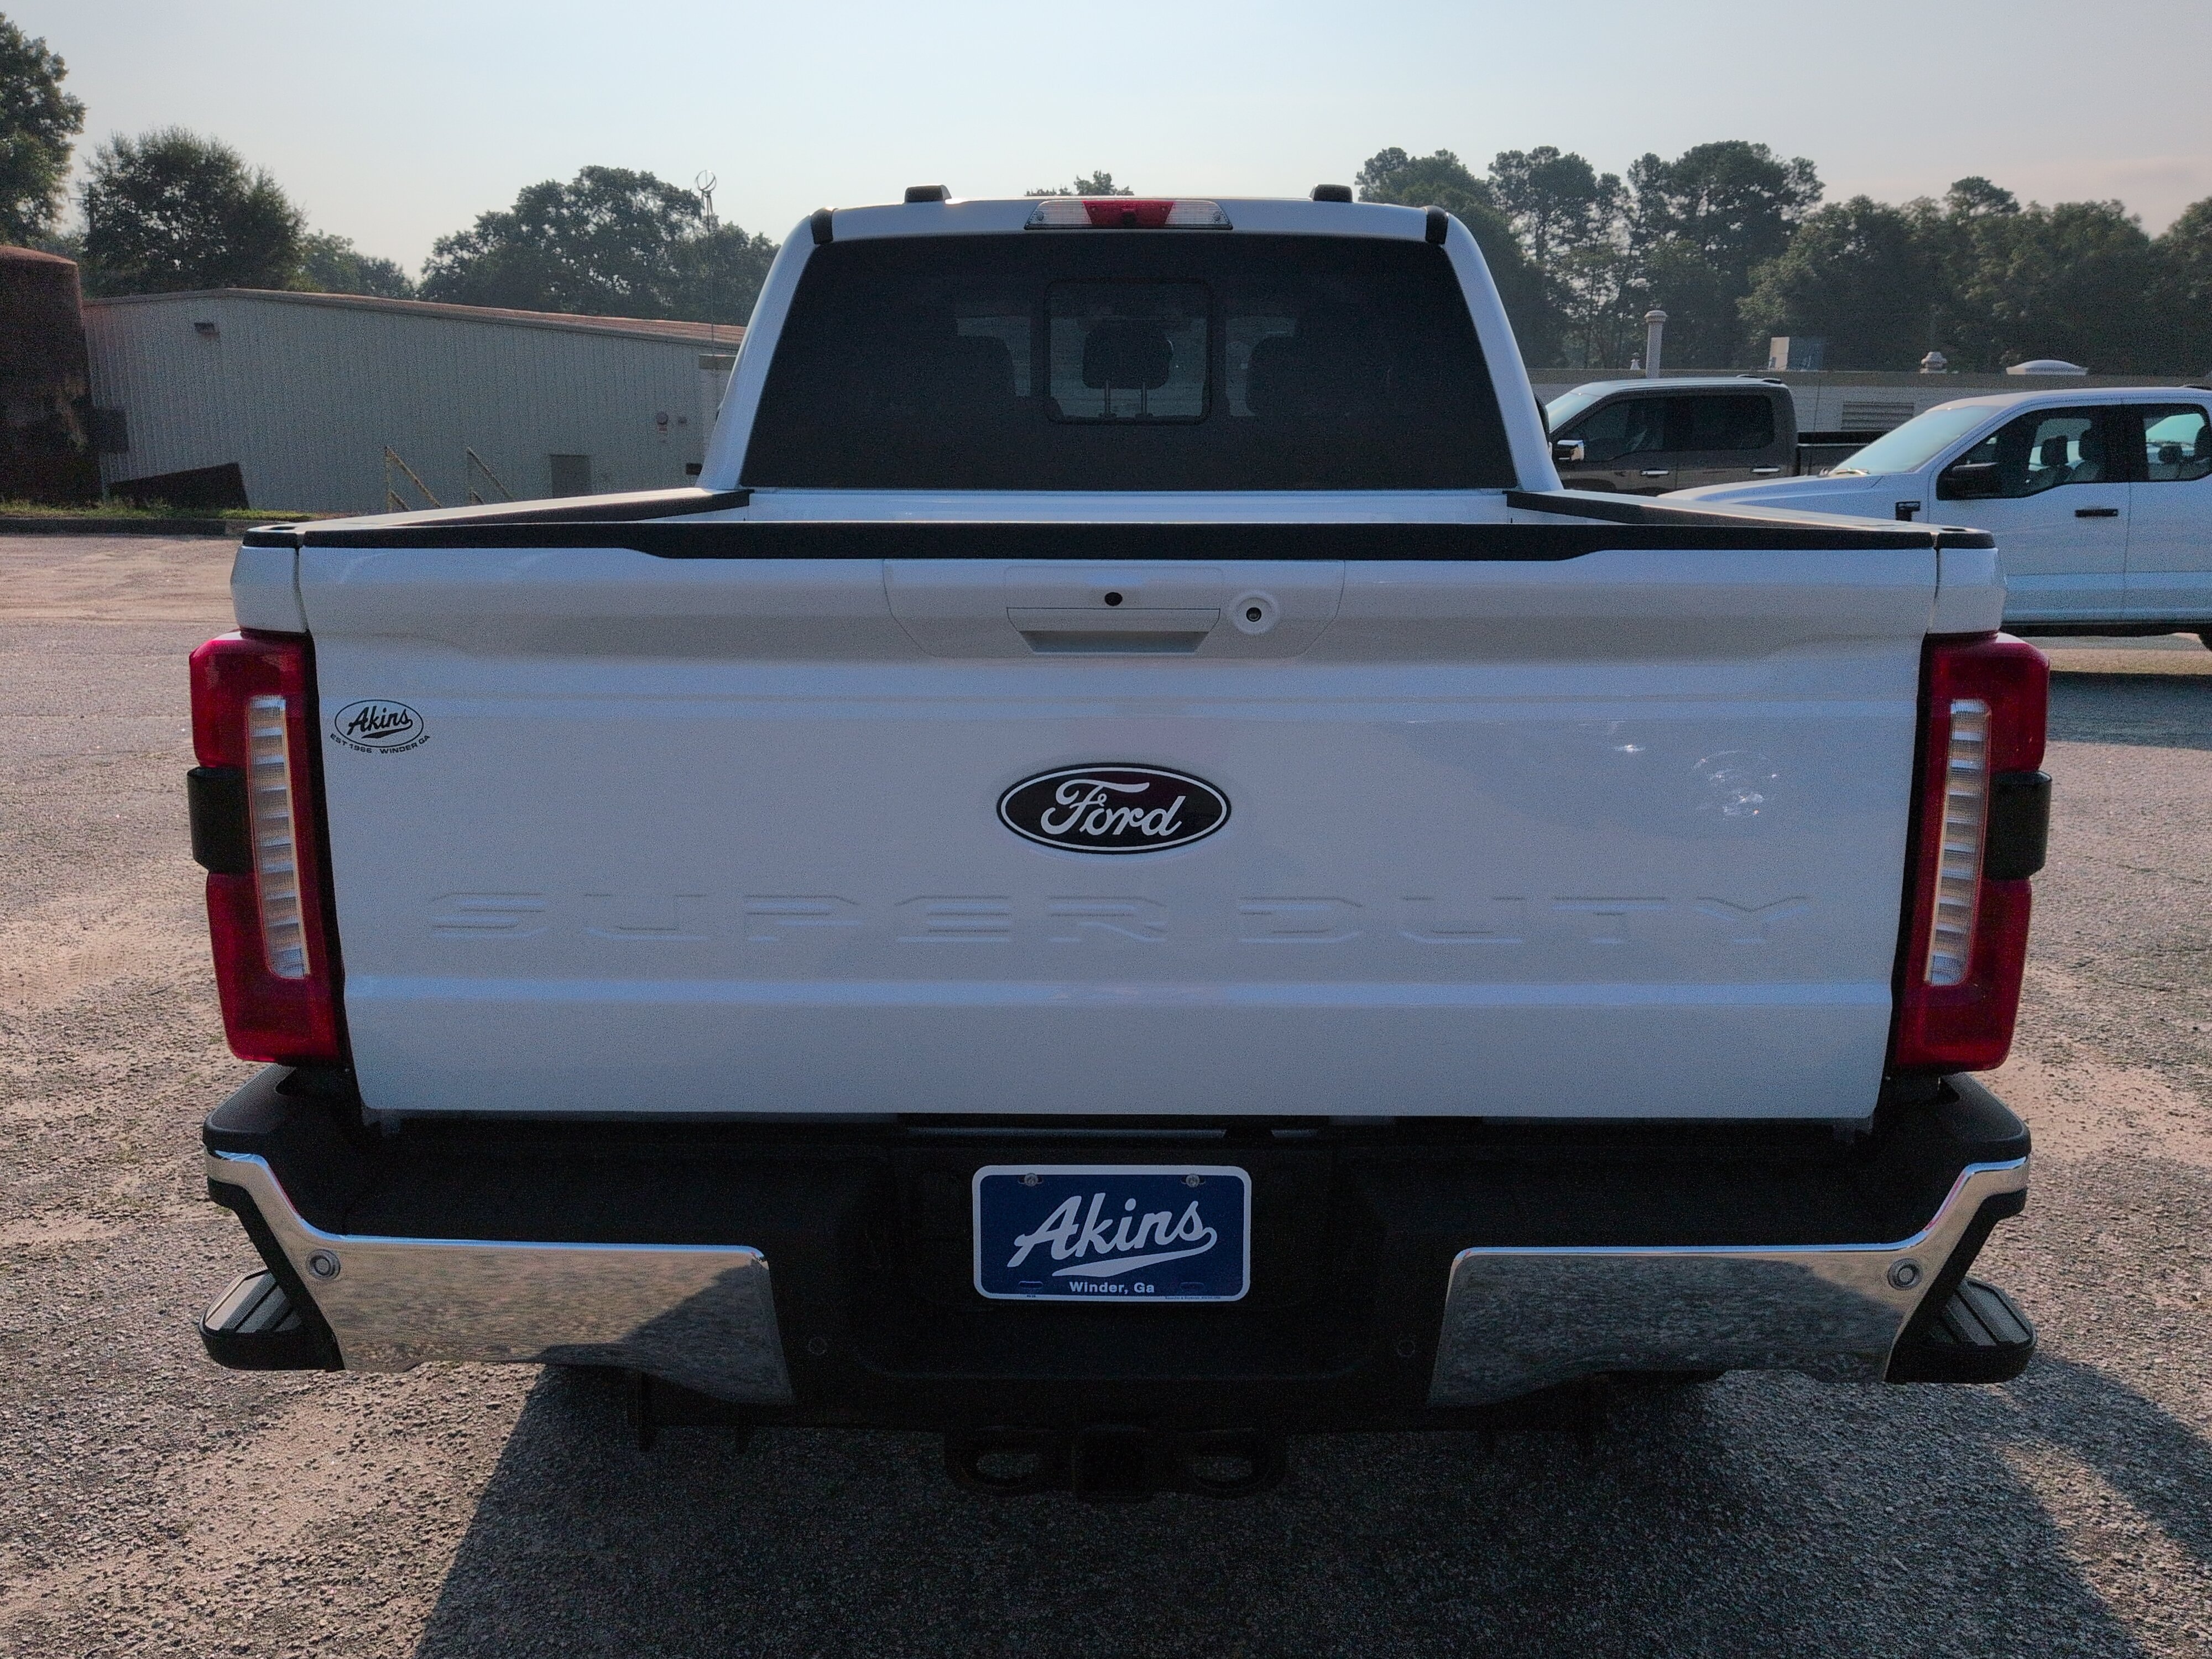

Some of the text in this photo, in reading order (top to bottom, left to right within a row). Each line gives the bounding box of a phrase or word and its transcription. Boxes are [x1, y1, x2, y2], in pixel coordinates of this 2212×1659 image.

[347, 706, 413, 735] Akins
[330, 733, 348, 746] EST
[379, 742, 418, 754] WINDER
[418, 735, 431, 744] GA
[1041, 779, 1187, 836] Ford
[430, 892, 1808, 945] SUPER DUTY
[1007, 1193, 1211, 1268] Akins
[1069, 1281, 1155, 1295] Winder, Ga
